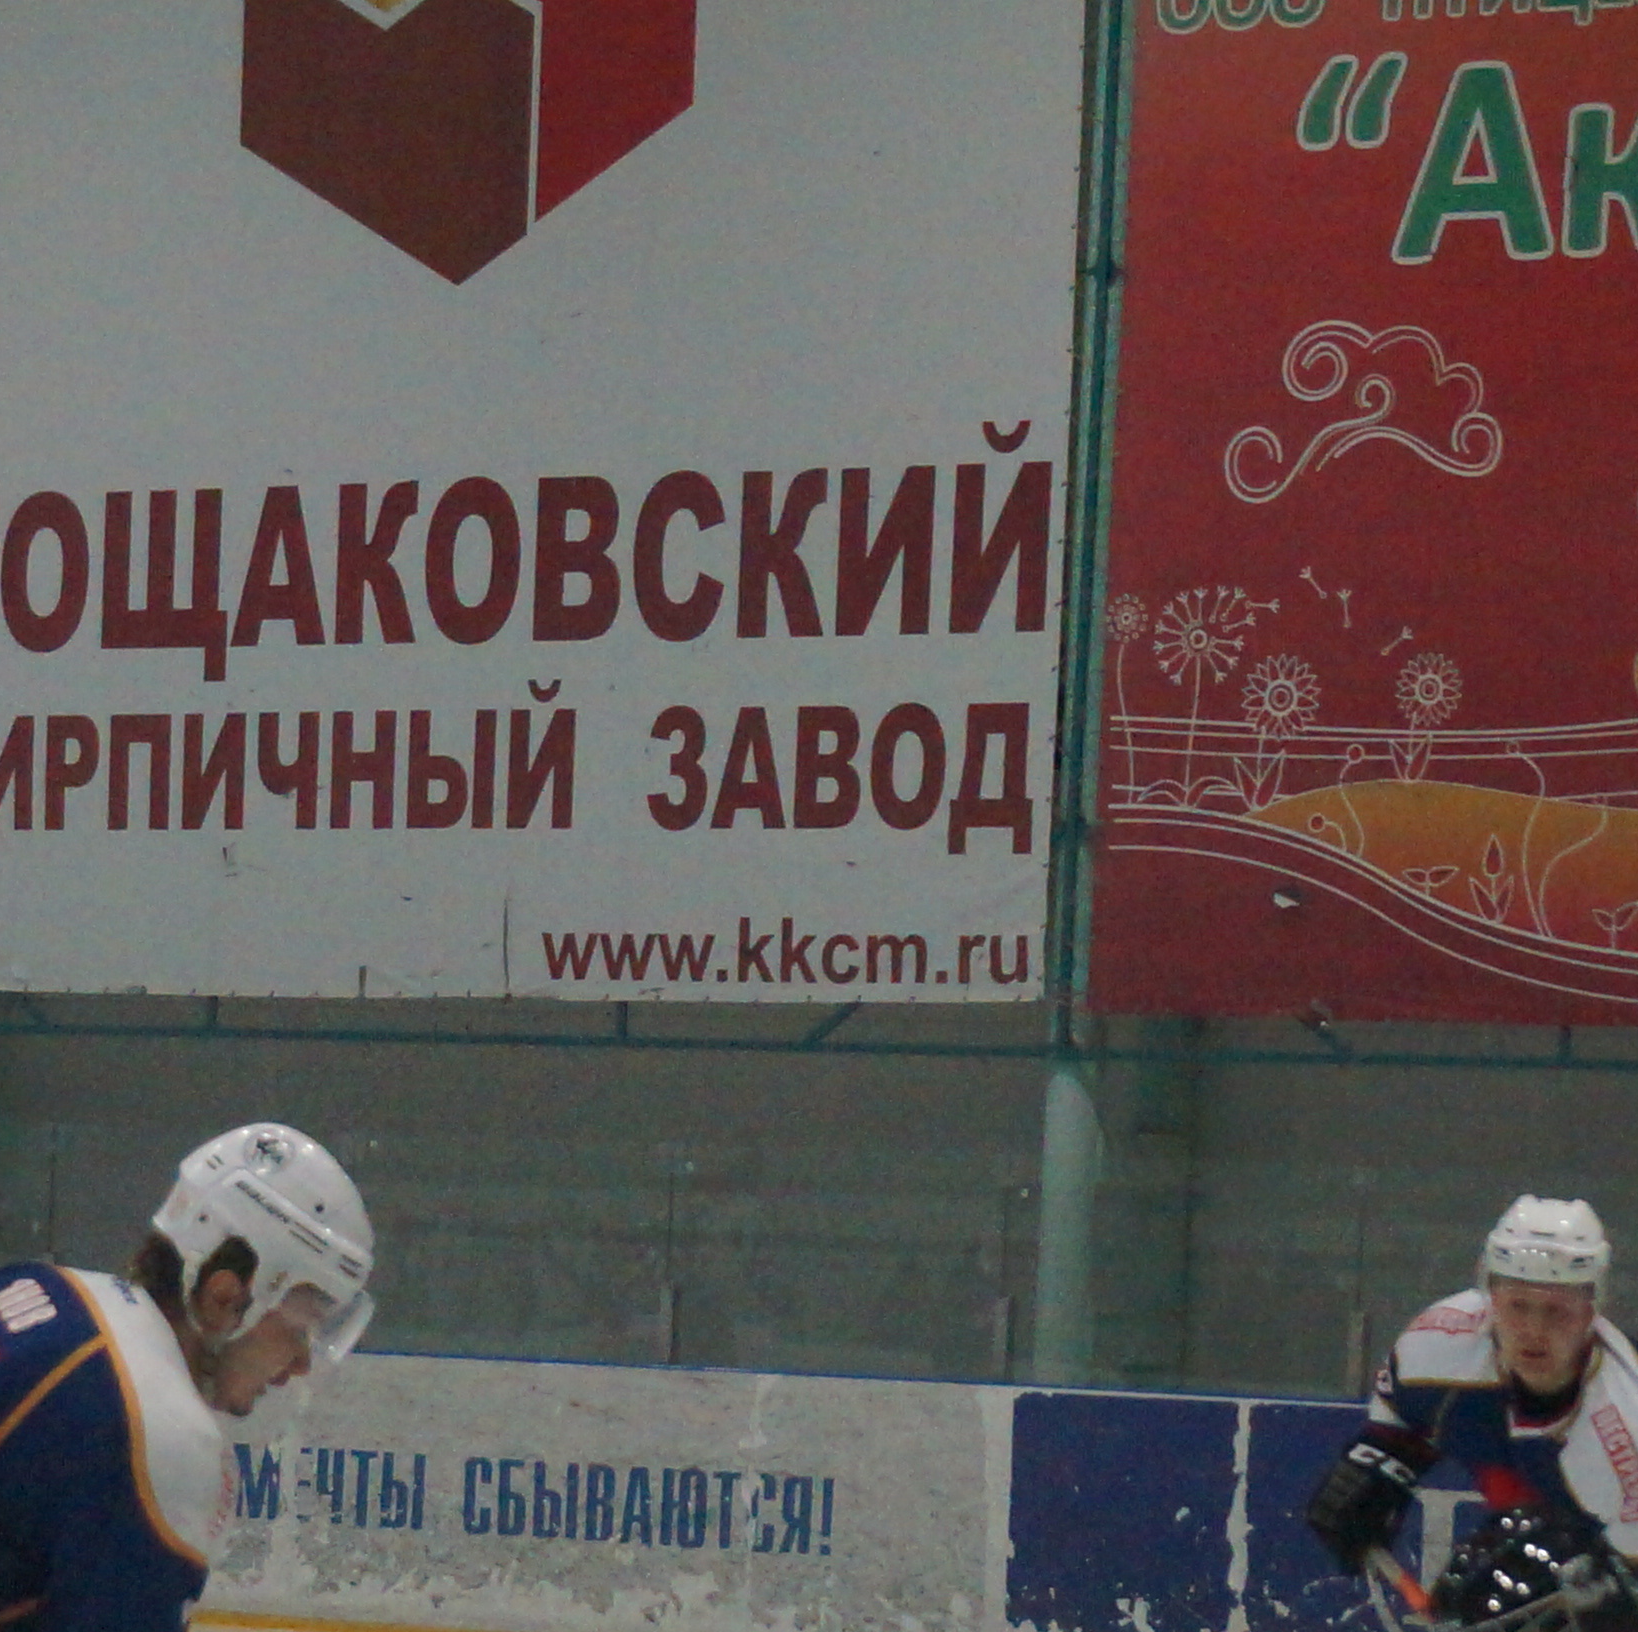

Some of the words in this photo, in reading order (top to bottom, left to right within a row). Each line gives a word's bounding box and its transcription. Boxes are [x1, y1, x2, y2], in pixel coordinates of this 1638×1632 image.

[646, 700, 1036, 856] ЗАВОД
[541, 917, 1032, 986] www.kkcm.ru
[463, 1454, 836, 1557] СБЫВАЮТСЯ!
